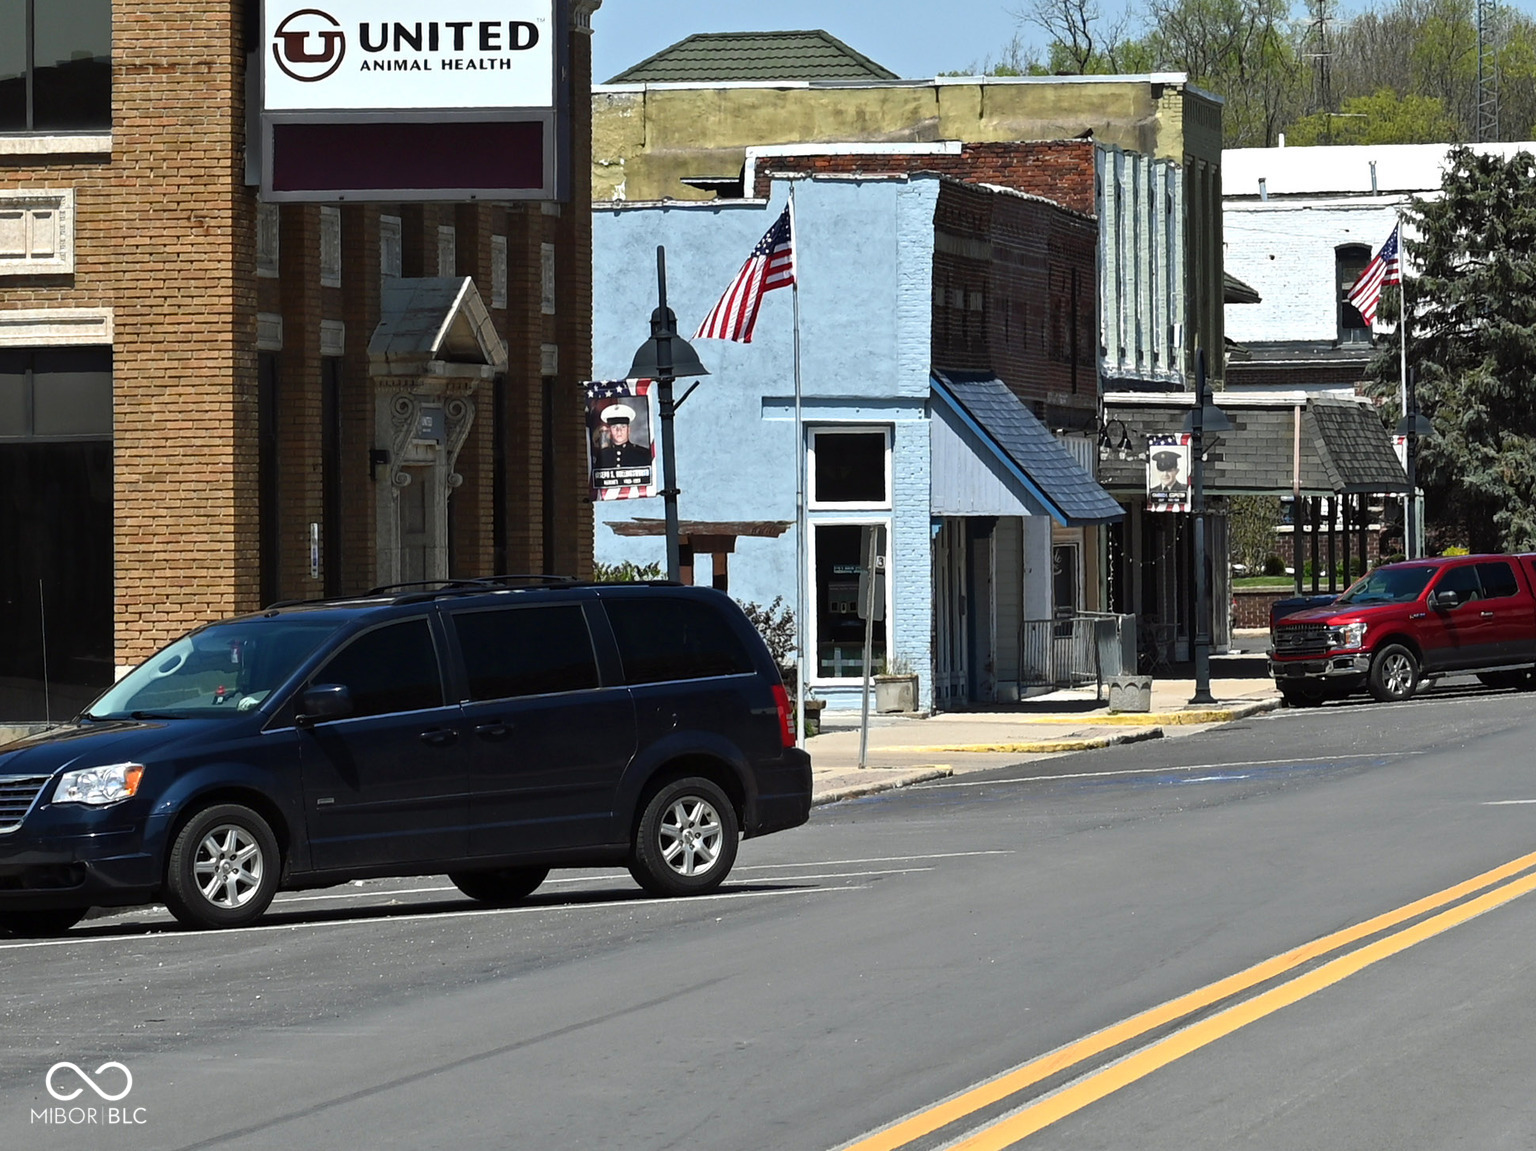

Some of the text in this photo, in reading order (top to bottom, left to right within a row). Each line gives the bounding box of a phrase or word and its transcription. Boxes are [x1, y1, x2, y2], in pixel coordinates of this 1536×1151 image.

[359, 21, 539, 52] UNITED
[360, 58, 512, 71] ANIMAL HEALTH
